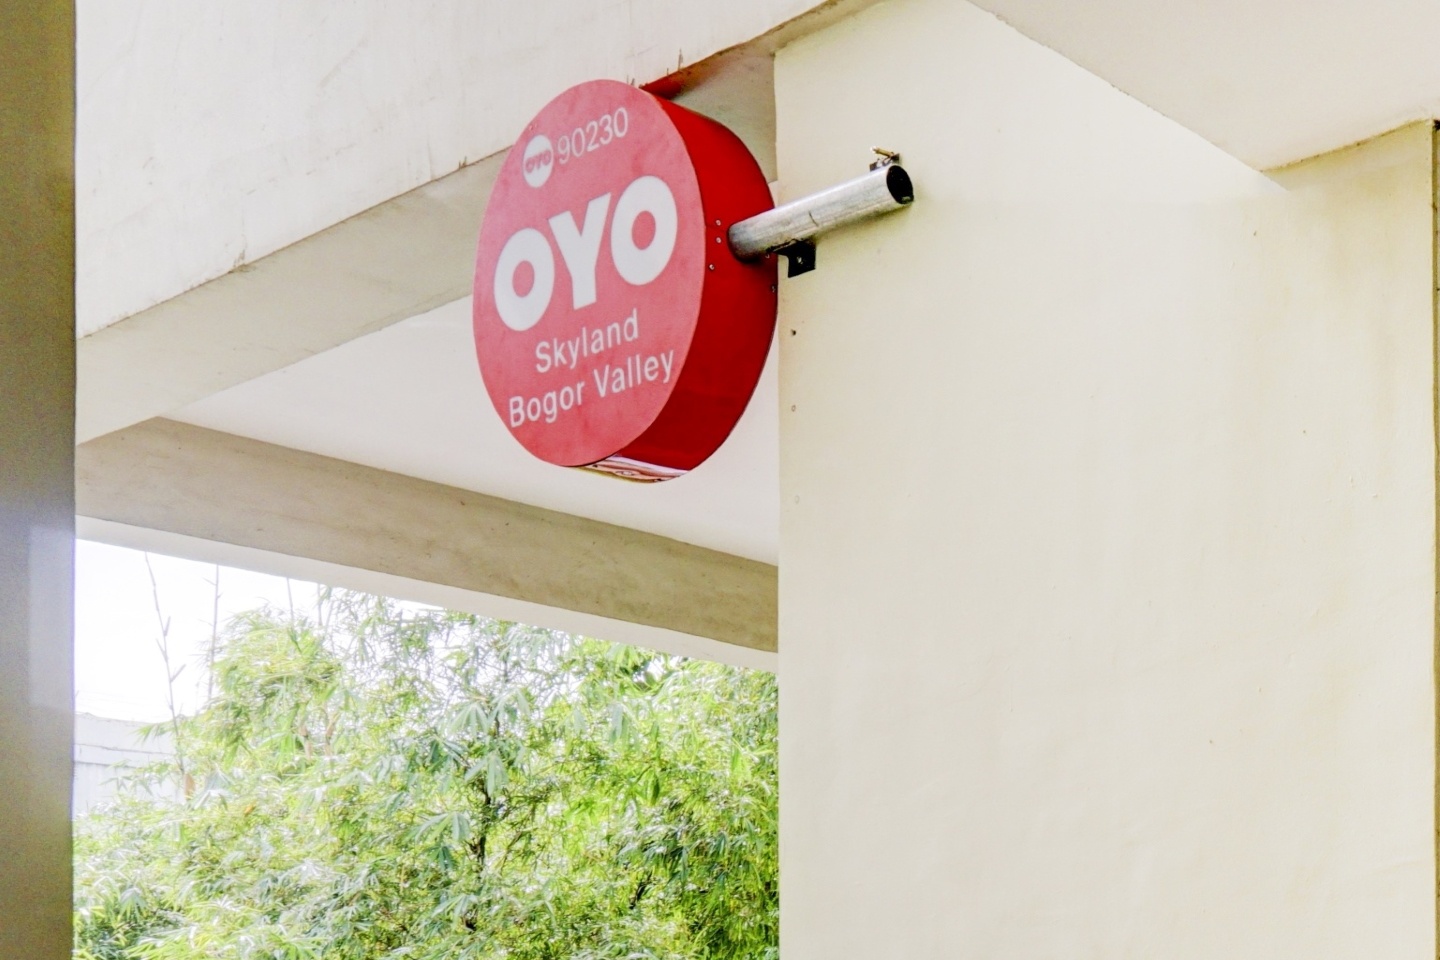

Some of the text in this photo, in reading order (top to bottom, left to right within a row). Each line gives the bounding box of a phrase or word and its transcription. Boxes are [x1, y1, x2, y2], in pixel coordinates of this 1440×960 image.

[525, 107, 629, 174] OYO 90230
[493, 175, 678, 332] OYO
[535, 308, 639, 373] Skyland
[509, 349, 674, 427] Bogor Valley
